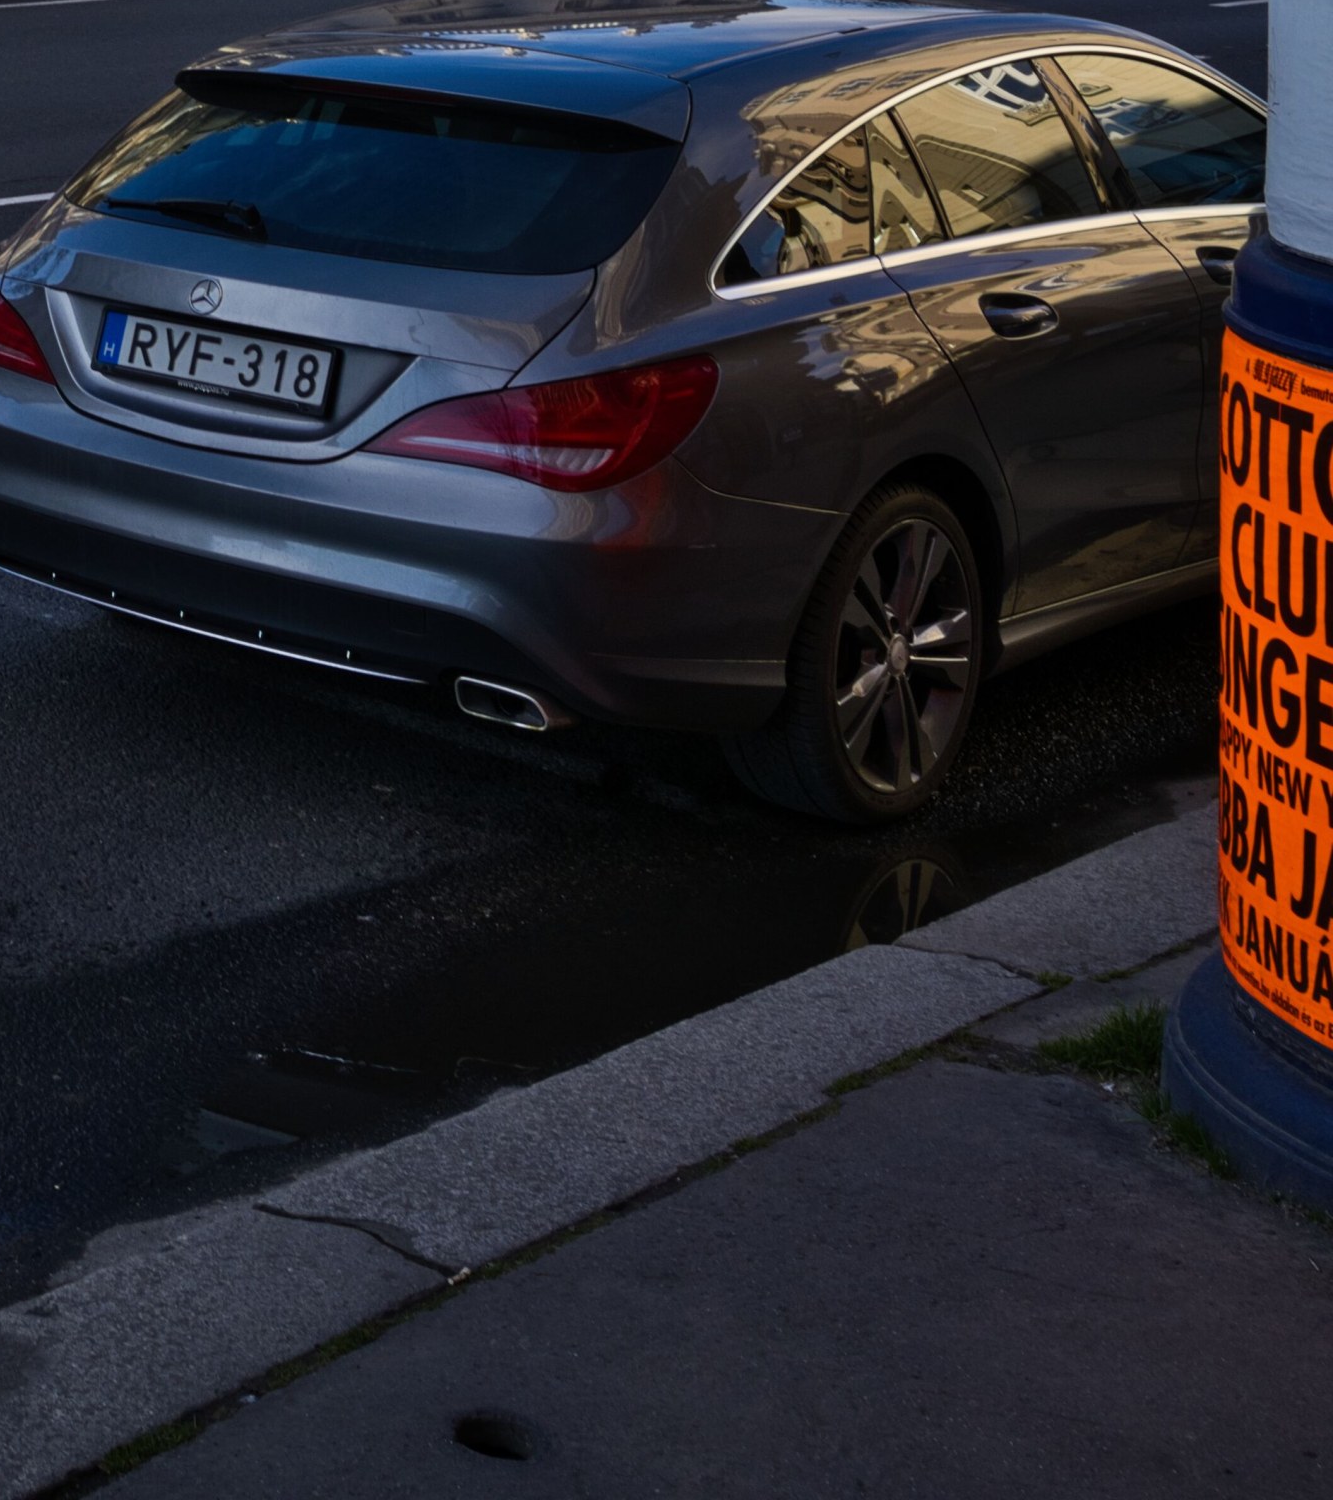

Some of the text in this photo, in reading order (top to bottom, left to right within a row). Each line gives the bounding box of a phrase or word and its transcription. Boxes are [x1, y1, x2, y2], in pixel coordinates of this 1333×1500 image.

[103, 341, 116, 359] H
[128, 322, 319, 399] RYF-318
[1257, 745, 1313, 816] NEW
